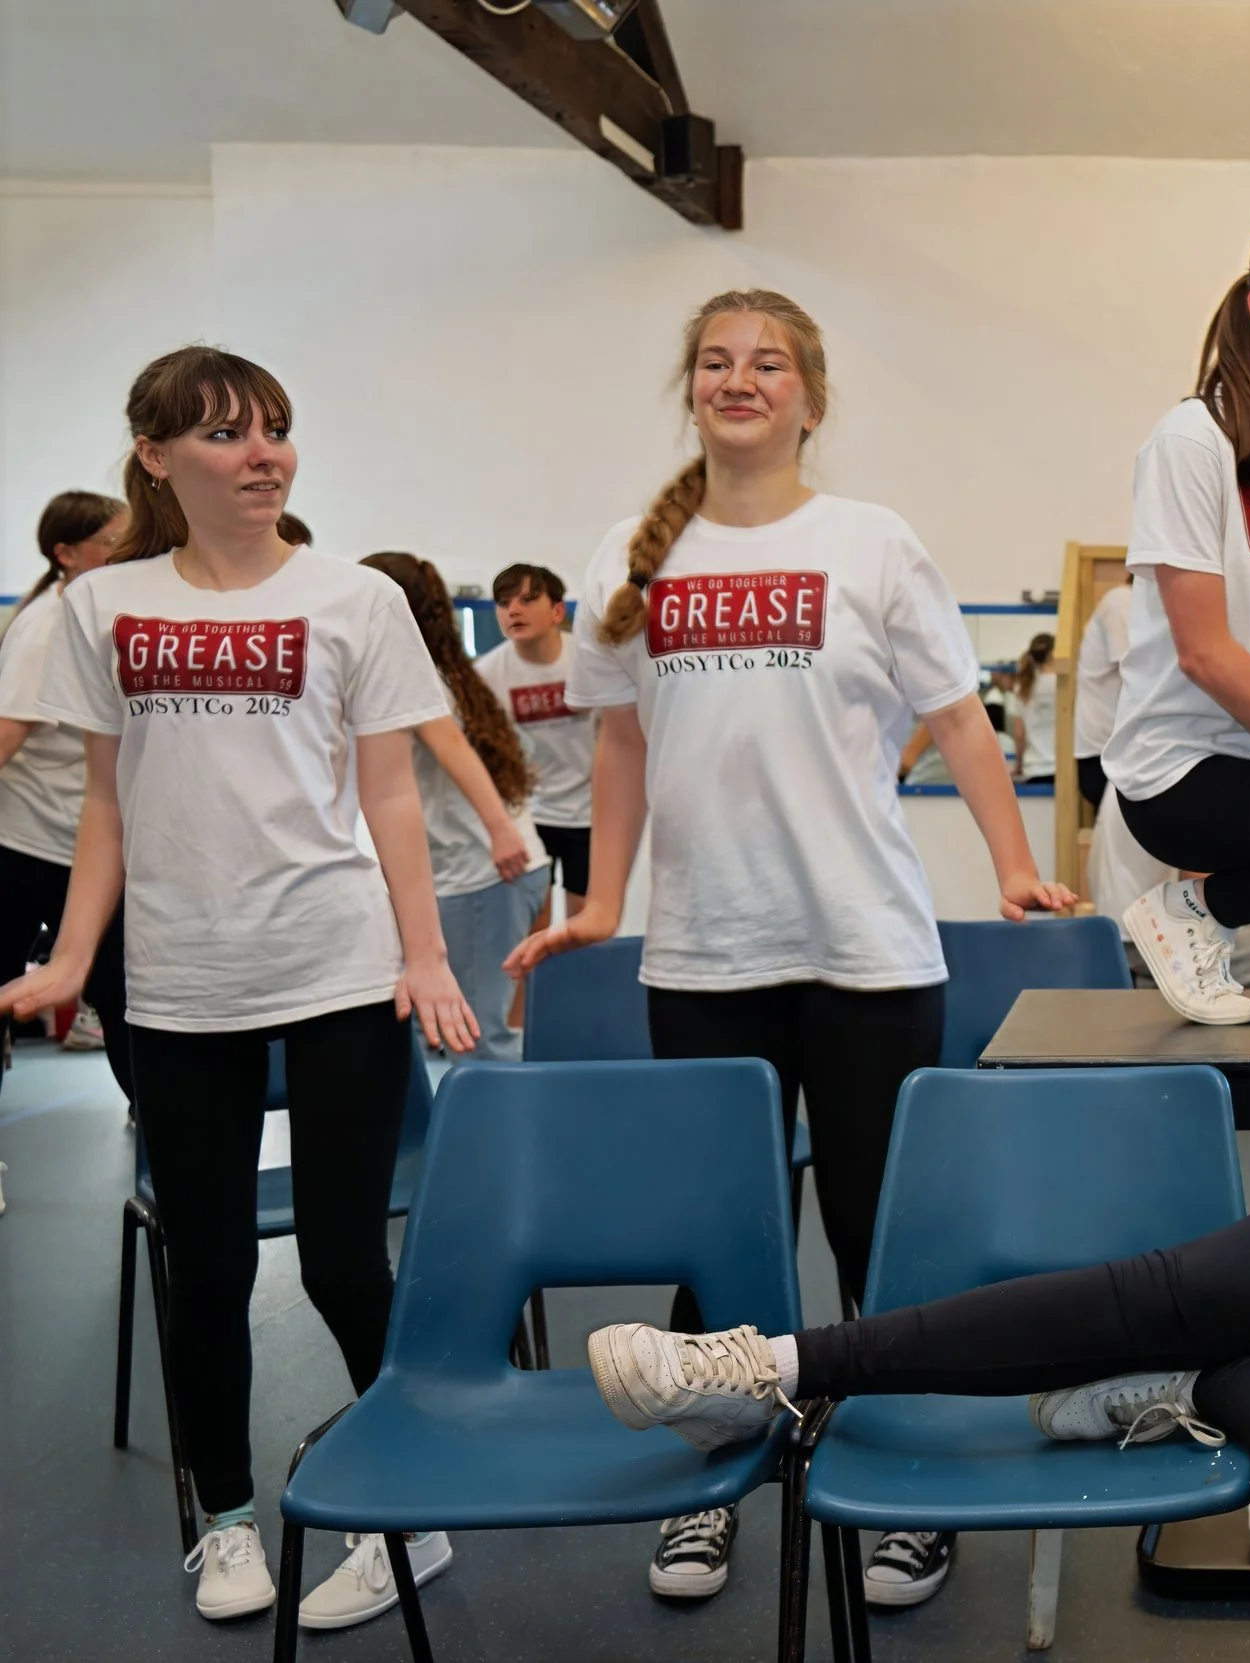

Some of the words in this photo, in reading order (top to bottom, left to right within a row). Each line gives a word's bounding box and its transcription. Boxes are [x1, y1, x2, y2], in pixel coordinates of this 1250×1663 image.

[687, 580, 702, 591] WE
[708, 579, 723, 590] GO
[730, 575, 786, 589] TOGETHER
[660, 588, 814, 632] GREASE
[158, 622, 176, 634] WE
[182, 623, 197, 633] GO
[204, 623, 266, 634] TOGETHER
[682, 632, 707, 645] THE
[718, 629, 783, 643] MUSICAL
[129, 633, 294, 674] GREASE
[655, 653, 755, 677] DOSYTCo
[765, 649, 813, 669] 2025
[152, 674, 181, 687] THE
[192, 675, 264, 688] MUSICAL
[245, 697, 292, 716] 2025
[516, 693, 565, 715] GREA
